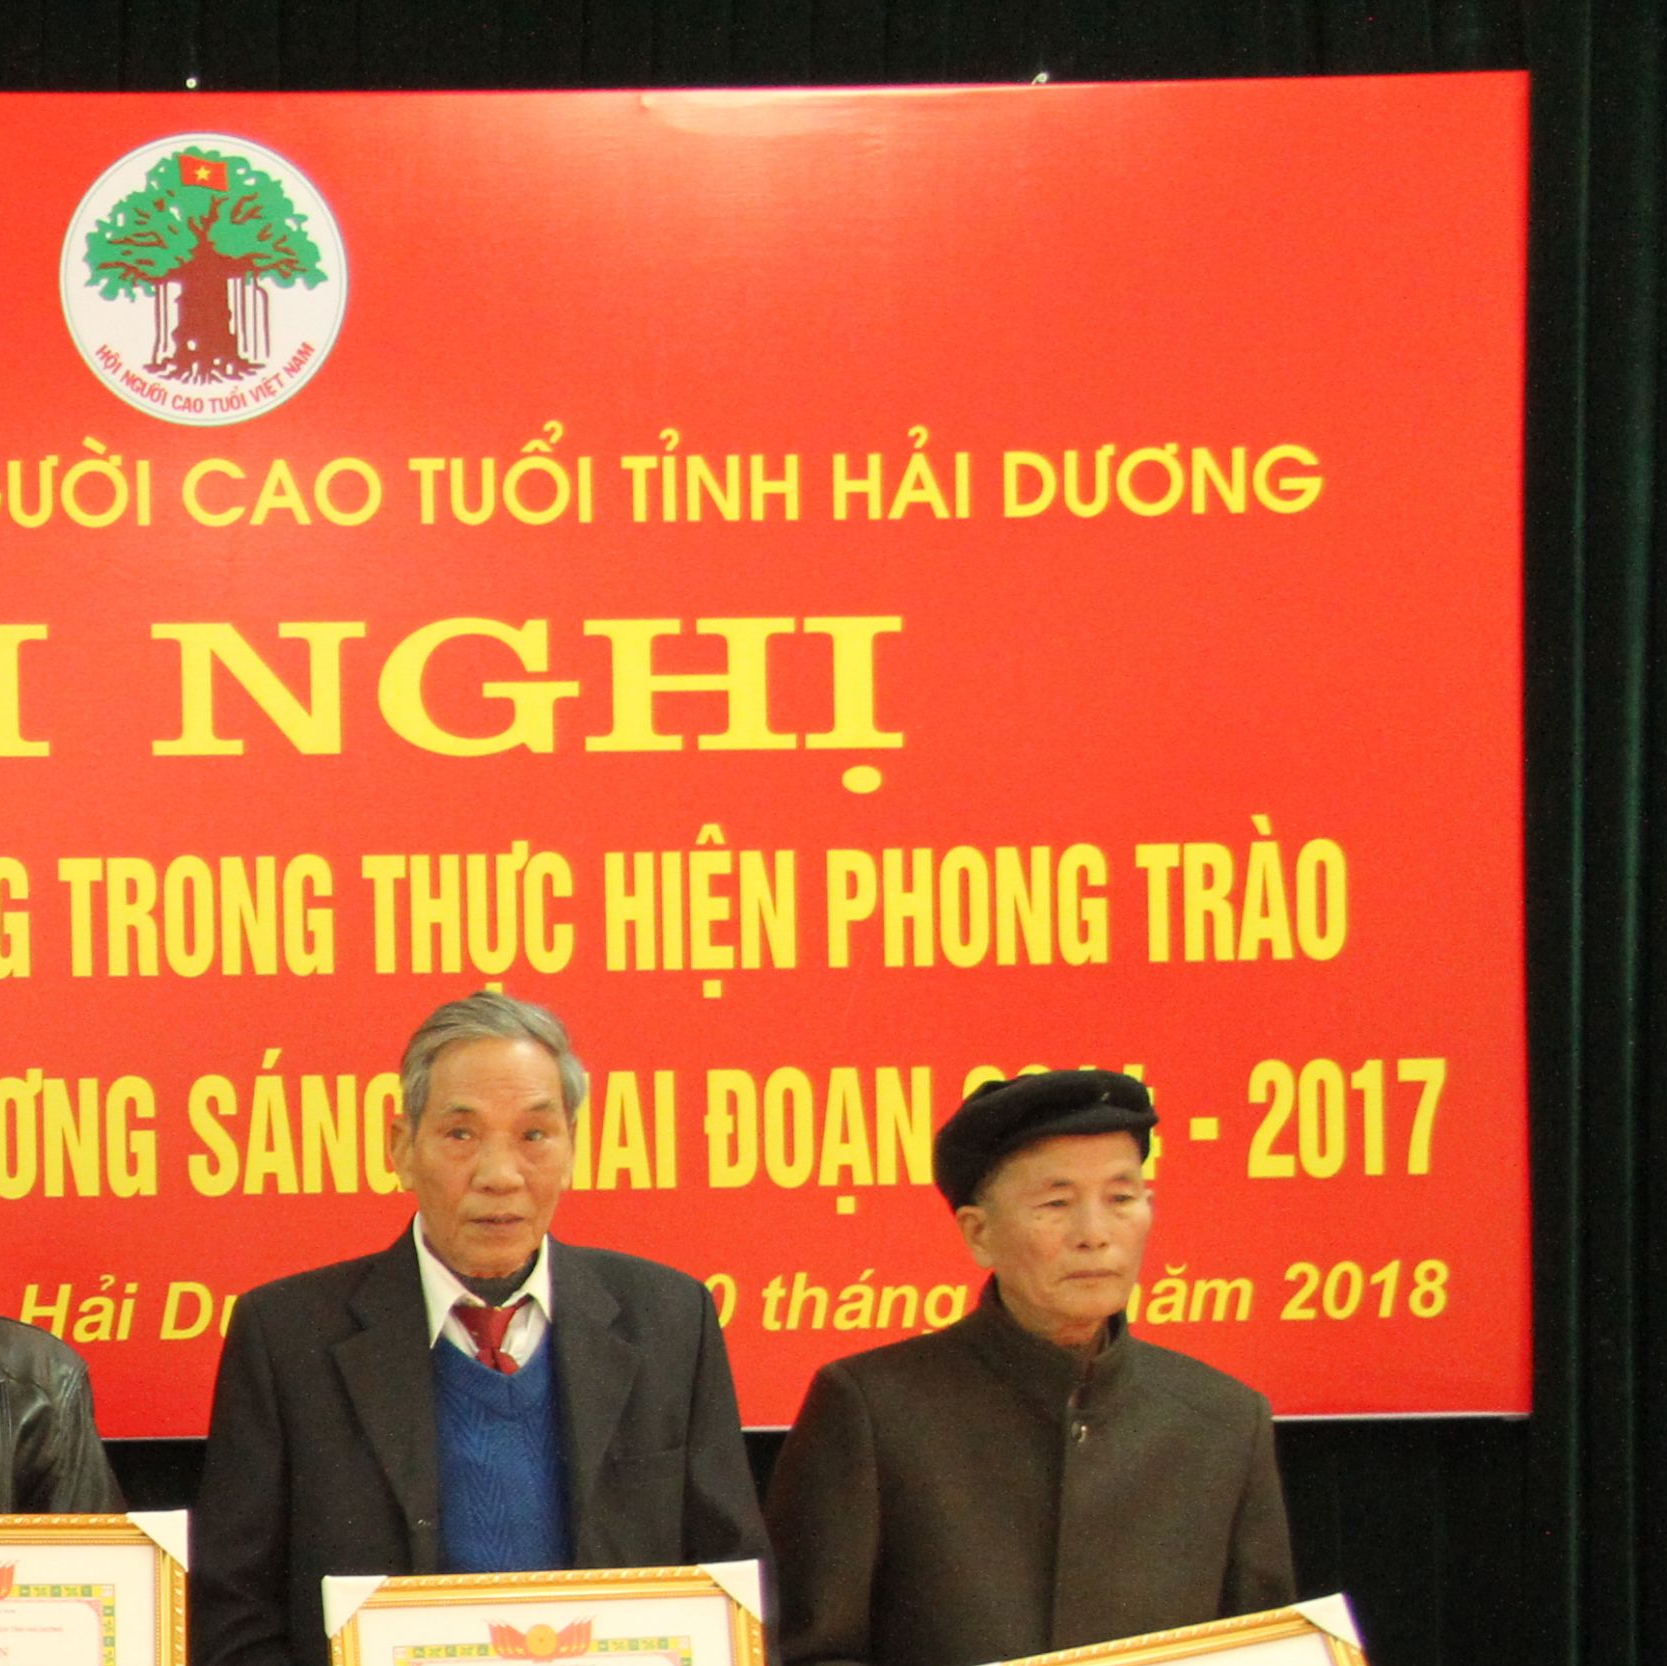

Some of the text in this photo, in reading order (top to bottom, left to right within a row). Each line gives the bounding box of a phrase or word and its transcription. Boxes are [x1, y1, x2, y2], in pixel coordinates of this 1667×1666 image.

[95, 341, 315, 414] HỘI NGƯỜI CAO TUỔI VIỆT NAM
[181, 457, 384, 528] CAO
[407, 419, 594, 527] TUỔI
[620, 427, 801, 523] TỈNH
[832, 424, 971, 521] HẢI
[1002, 442, 1324, 520] DƯƠNG
[149, 614, 906, 796] NGHỊ
[57, 852, 336, 980] TRONG
[361, 839, 576, 994] THỰC
[603, 822, 798, 1000] HIỆN
[826, 842, 1110, 970] PHONG
[1134, 813, 1349, 964] TRÀO
[571, 1070, 677, 1192] IAI
[703, 1065, 934, 1215] ĐOẠN
[1189, 1116, 1220, 1141] -
[1247, 1057, 1447, 1180] 2017
[19, 1274, 138, 1343] Hải
[761, 1268, 969, 1336] tháng
[1279, 1259, 1450, 1322] 2018
